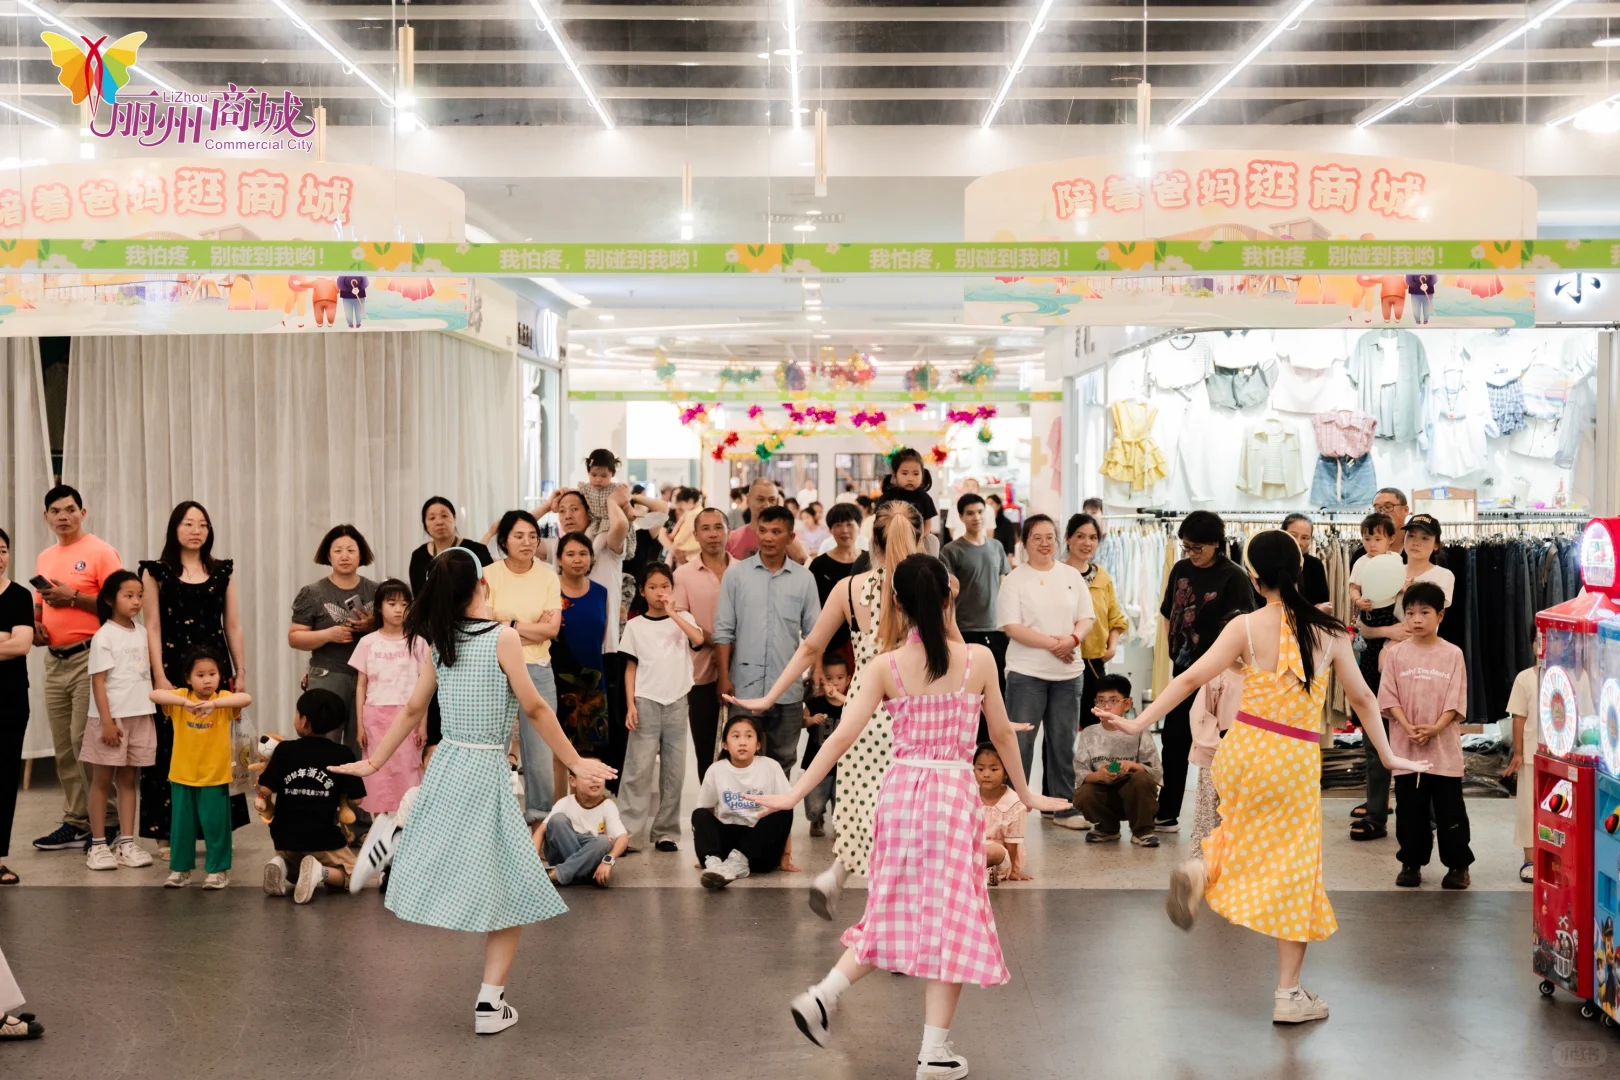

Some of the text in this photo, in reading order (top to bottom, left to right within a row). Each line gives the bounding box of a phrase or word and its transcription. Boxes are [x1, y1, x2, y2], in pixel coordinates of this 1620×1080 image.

[1053, 161, 1426, 220] 陪着爸妈逛商城
